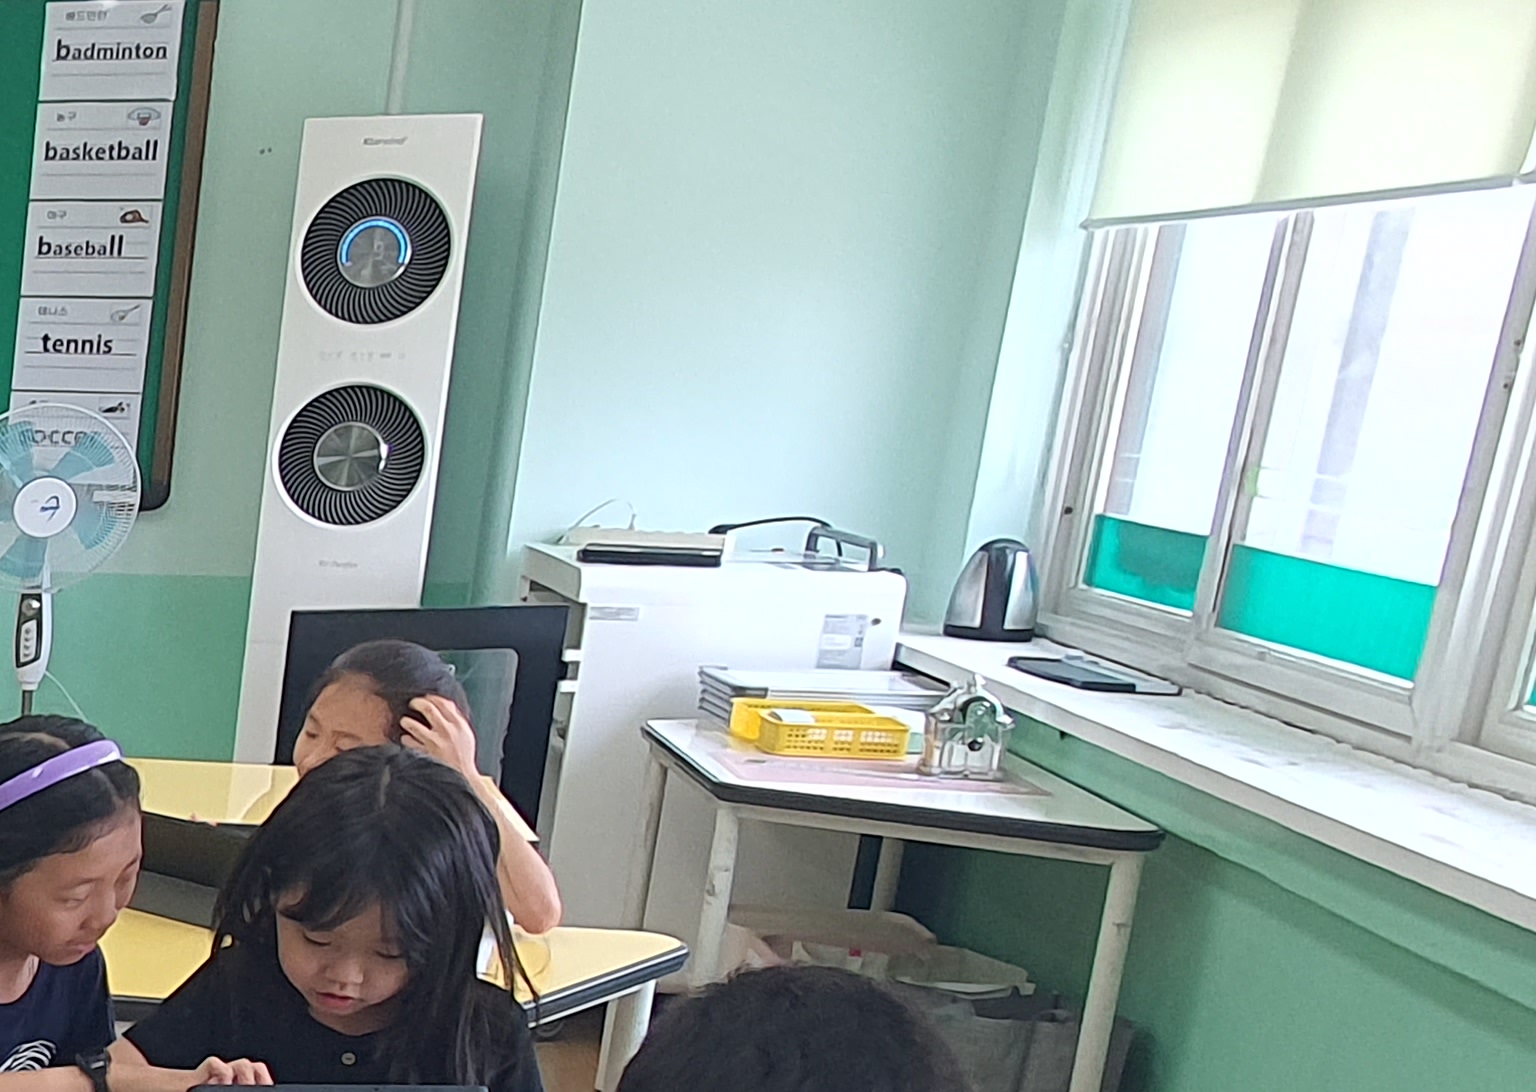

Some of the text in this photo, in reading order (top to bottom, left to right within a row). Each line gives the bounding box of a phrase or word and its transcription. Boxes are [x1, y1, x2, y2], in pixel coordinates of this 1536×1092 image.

[56, 38, 168, 61] badminton
[44, 138, 159, 161] basketball
[37, 233, 125, 257] baseball
[41, 332, 115, 355] tennis
